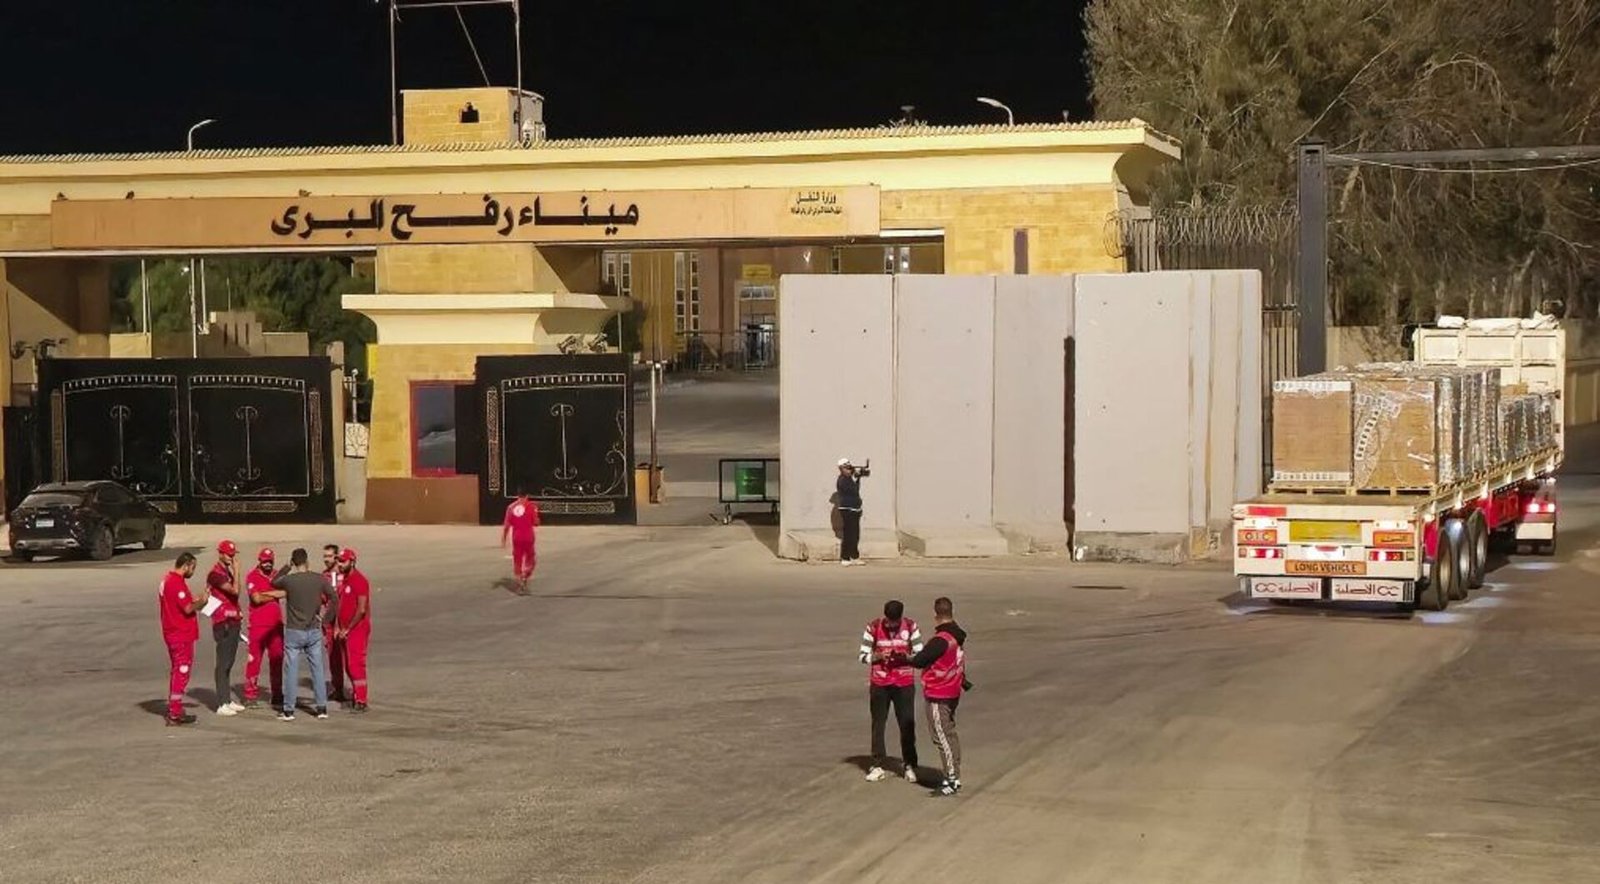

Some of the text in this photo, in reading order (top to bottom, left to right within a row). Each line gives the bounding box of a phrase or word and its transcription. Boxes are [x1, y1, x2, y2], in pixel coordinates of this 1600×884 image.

[391, 193, 514, 240] رفح
[518, 194, 640, 236] ميناء
[1295, 563, 1358, 573] LONG VEHICLE
